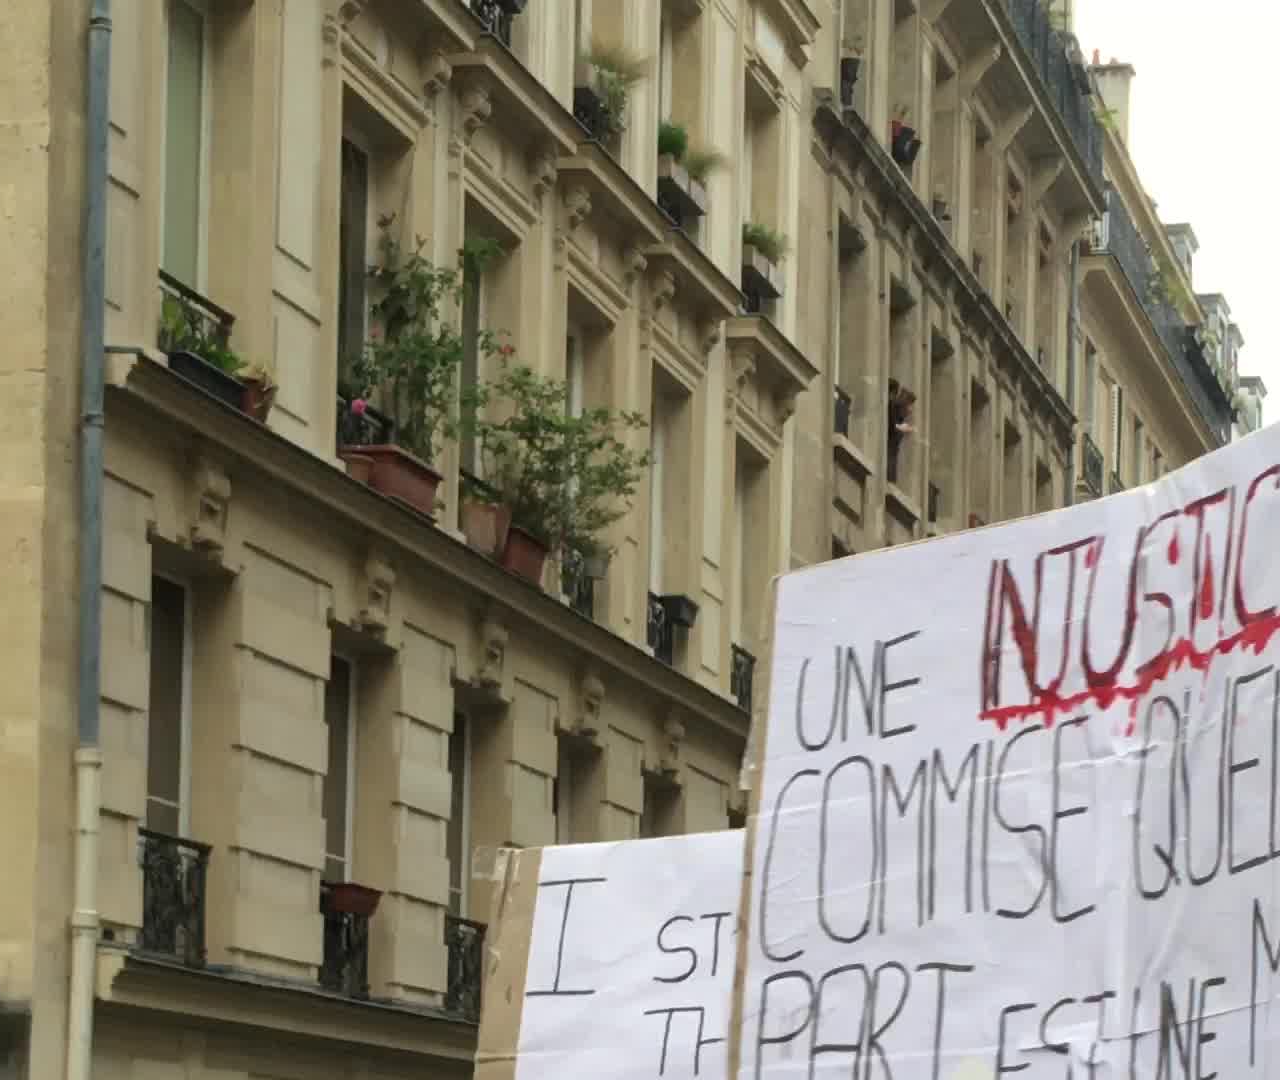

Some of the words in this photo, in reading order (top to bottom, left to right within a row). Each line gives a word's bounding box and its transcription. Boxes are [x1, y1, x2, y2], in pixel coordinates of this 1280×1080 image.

[798, 631, 921, 752] UNE
[760, 716, 1098, 962] COMMISE
[525, 876, 607, 997] I
